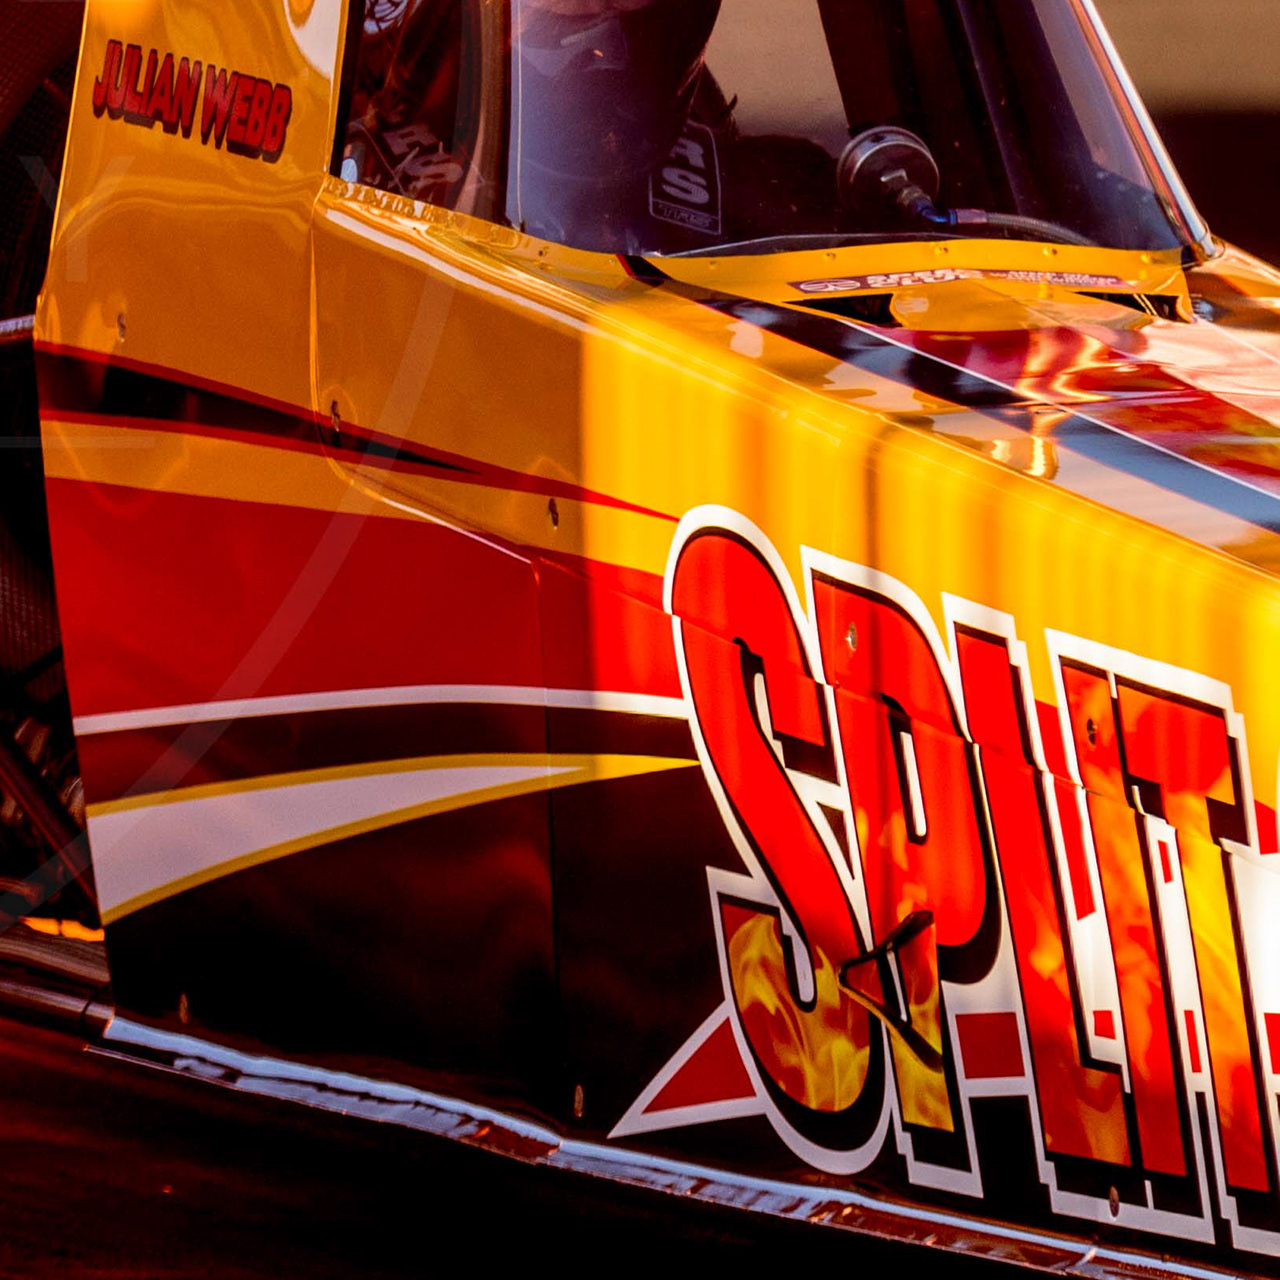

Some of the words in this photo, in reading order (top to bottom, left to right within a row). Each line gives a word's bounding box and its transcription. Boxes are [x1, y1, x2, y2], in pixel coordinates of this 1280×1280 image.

[92, 38, 202, 139] JULIAN
[201, 63, 292, 164] WEBB
[664, 505, 1280, 1257] SPLIT
